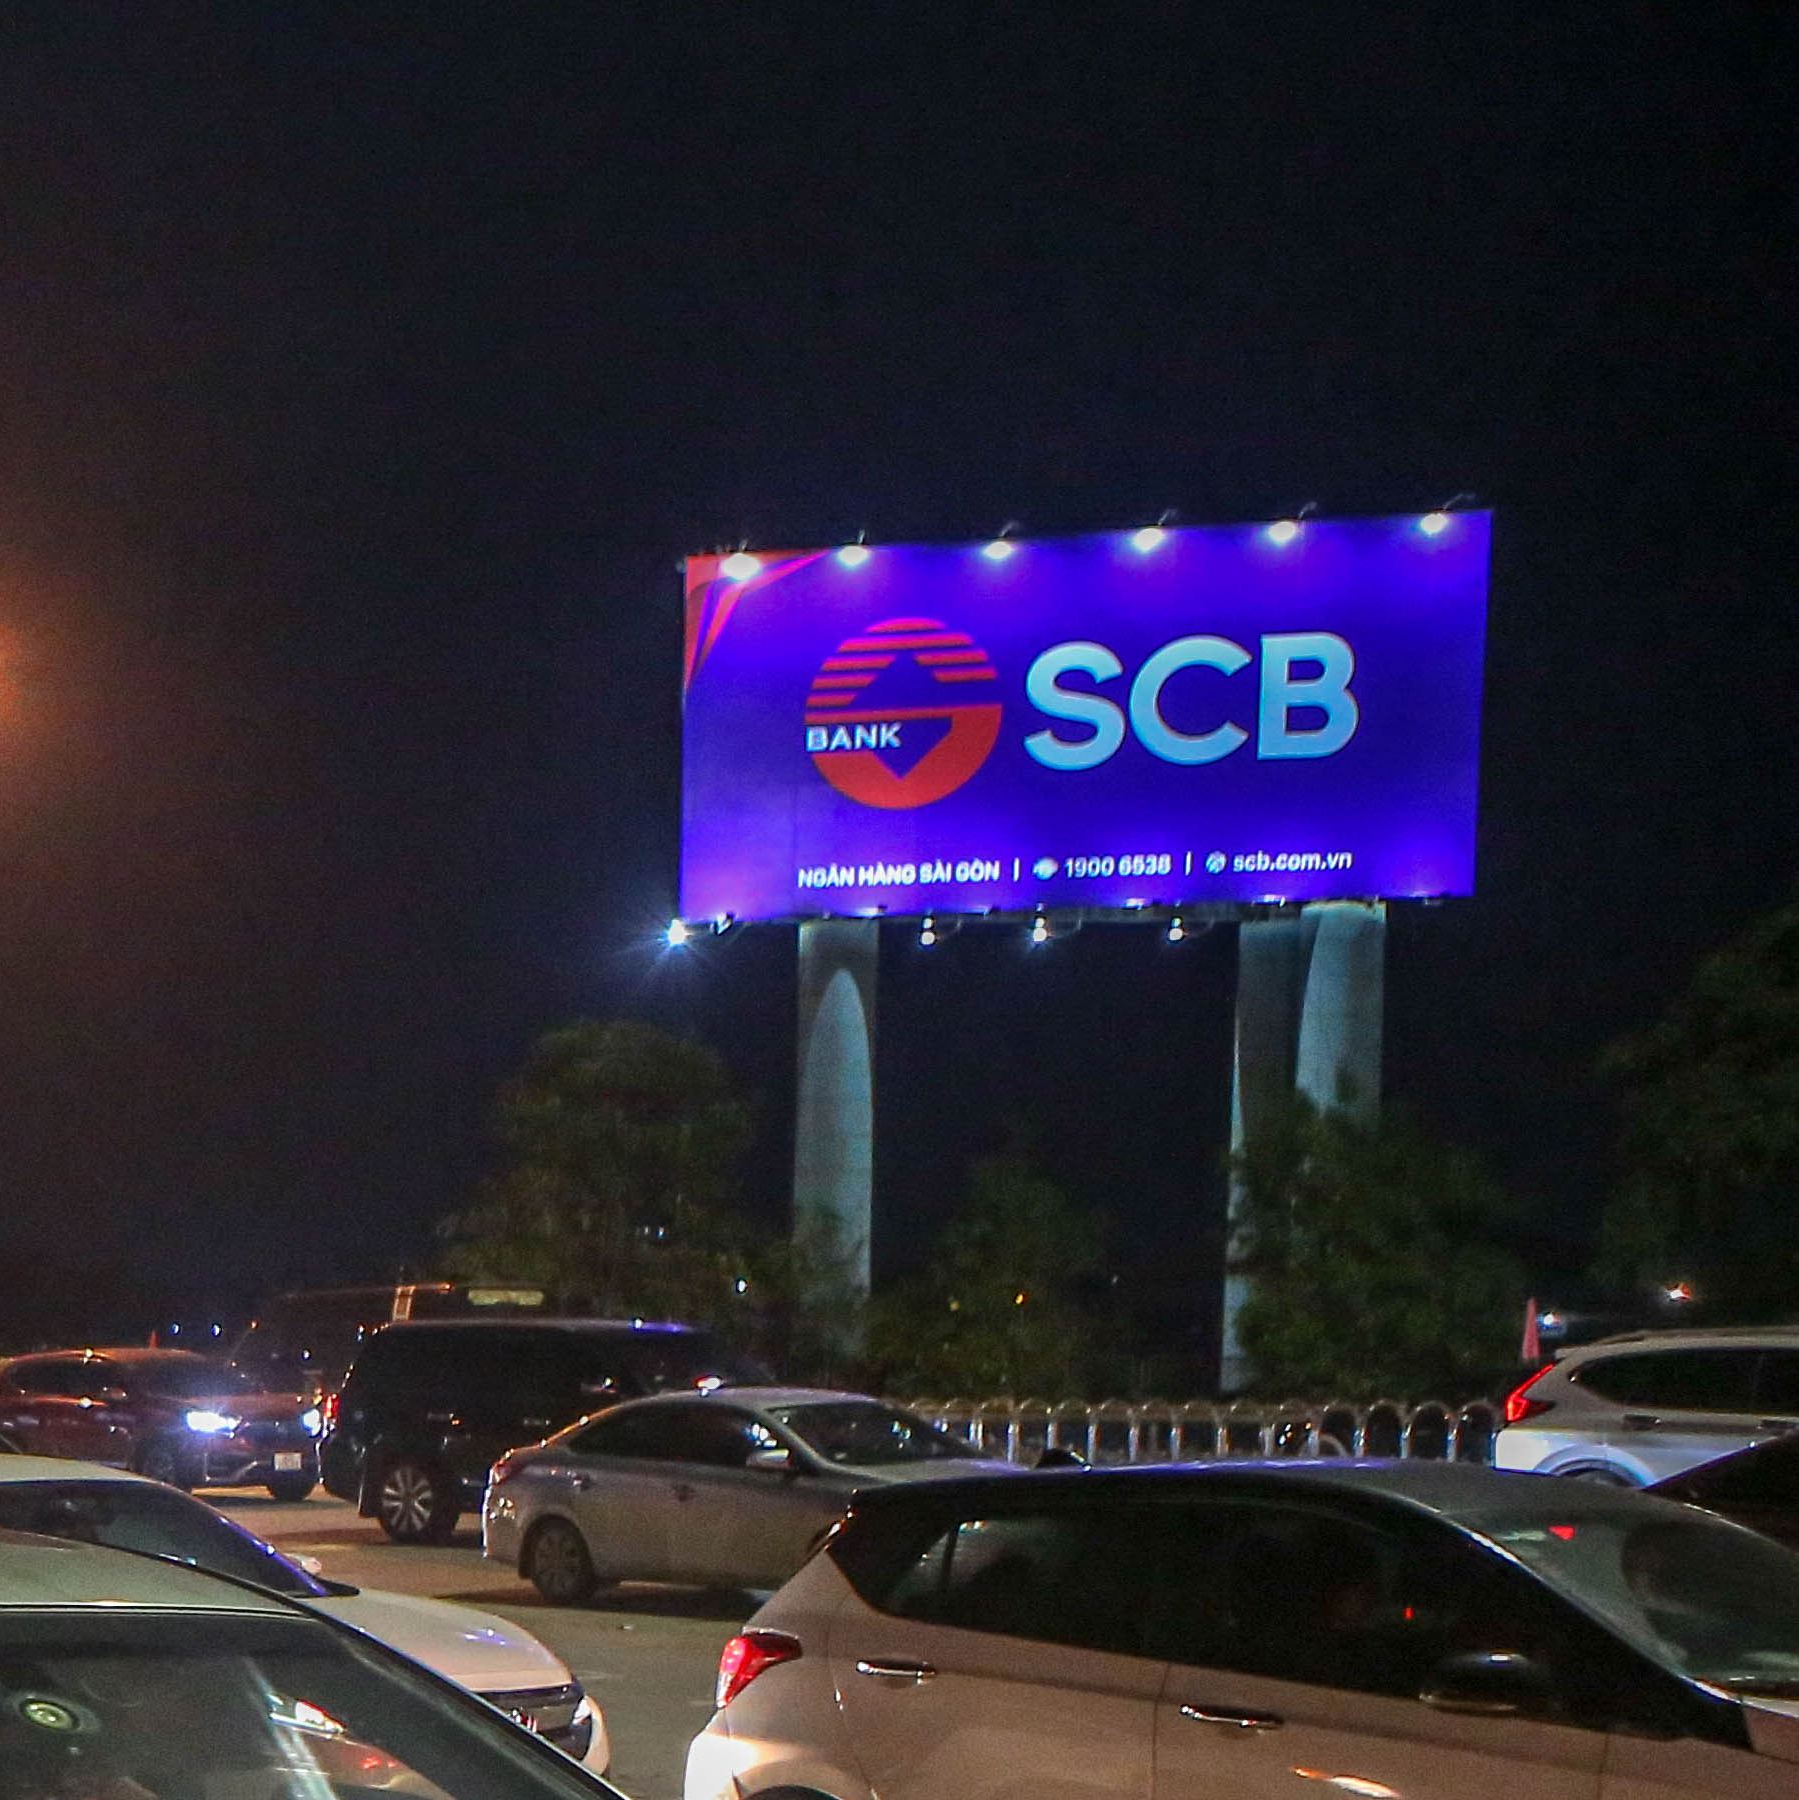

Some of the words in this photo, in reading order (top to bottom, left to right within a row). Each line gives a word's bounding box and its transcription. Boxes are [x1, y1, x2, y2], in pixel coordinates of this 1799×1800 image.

[1024, 631, 1360, 771] SCB
[805, 721, 902, 753] BANK
[1065, 855, 1115, 878] 1900
[1233, 850, 1352, 872] scb.com.vn
